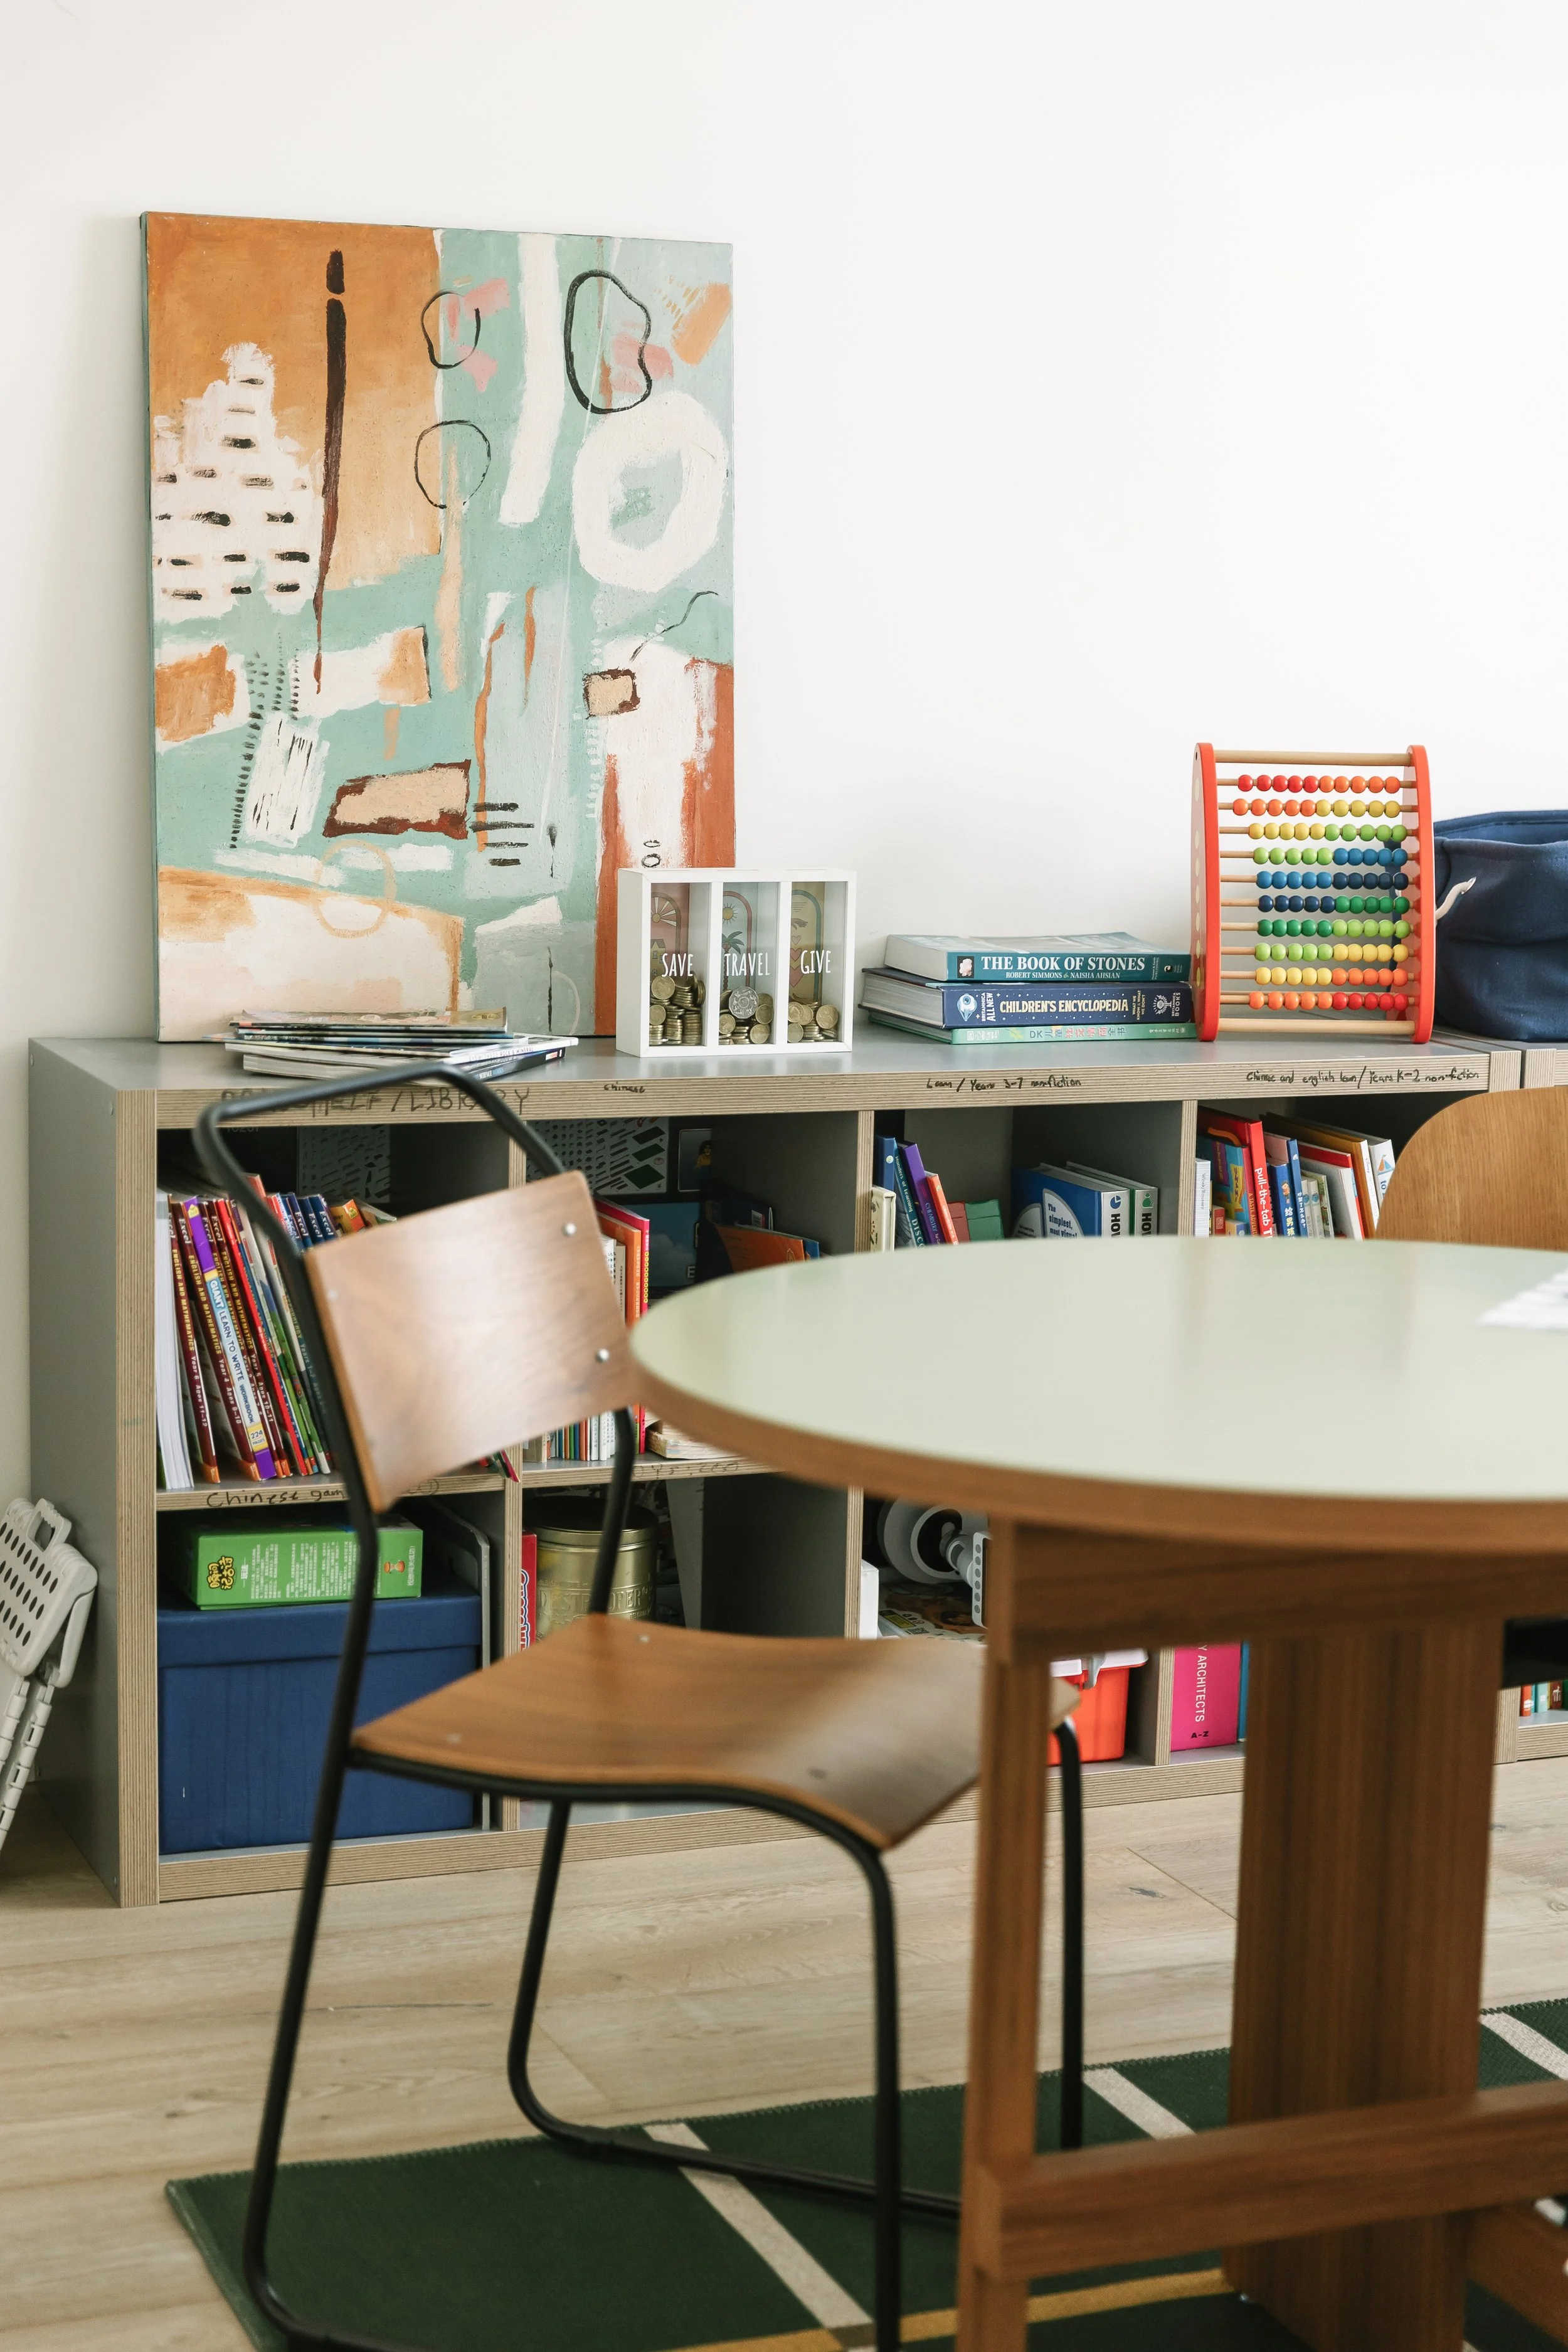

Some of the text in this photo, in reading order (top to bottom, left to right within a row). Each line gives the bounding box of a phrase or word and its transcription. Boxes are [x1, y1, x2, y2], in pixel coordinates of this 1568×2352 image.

[661, 953, 694, 977] SAVE
[724, 952, 770, 977] TRAVEL
[800, 950, 831, 974] GIVE
[981, 956, 1145, 970] THE BOOK OF STONES
[999, 999, 1129, 1013] CHILDREN'S ENCYCLOPEDIA
[1004, 1077, 1024, 1089] 3-7
[1280, 1069, 1295, 1083] and
[1302, 1071, 1335, 1086] english
[1397, 1069, 1421, 1083] K-2
[410, 1087, 531, 1116] LIBRY
[895, 1156, 904, 1179] Wonders
[904, 1189, 913, 1213] Learning
[1254, 1167, 1271, 1226] pull-the-tab
[925, 1202, 938, 1231] CHEMISTRY
[1047, 1203, 1056, 1213] The
[203, 1217, 214, 1242] Excel
[295, 1211, 309, 1236] Excel
[309, 1213, 323, 1237] Excel
[319, 1211, 334, 1236] Excel
[1049, 1214, 1073, 1230] simplest,
[1049, 1227, 1060, 1236] most
[1285, 1206, 1295, 1237] 给男孩
[172, 1249, 183, 1279] ENGLISH
[181, 1299, 194, 1351] MATHEMATICS
[178, 1218, 191, 1244] Excel
[189, 1255, 201, 1285] ENGLISH
[198, 1287, 206, 1301] AND
[203, 1303, 222, 1355] MATHEMATICS
[219, 1359, 227, 1375] Year
[226, 1387, 235, 1404] Ages
[211, 1216, 223, 1241] Excel
[221, 1251, 235, 1281] ENGLISH
[230, 1283, 238, 1297] AND
[235, 1299, 253, 1349] MATHEMATICS
[250, 1353, 258, 1370] Year
[257, 1382, 266, 1399] Ages
[210, 1280, 255, 1424] GIANT LEARN TO WRITE WORKBOOK
[251, 1429, 263, 1439] 224
[207, 1489, 344, 1508] Chinese gam
[1195, 1655, 1207, 1722] ARCHITECTS
[1190, 1730, 1209, 1739] A-Z
